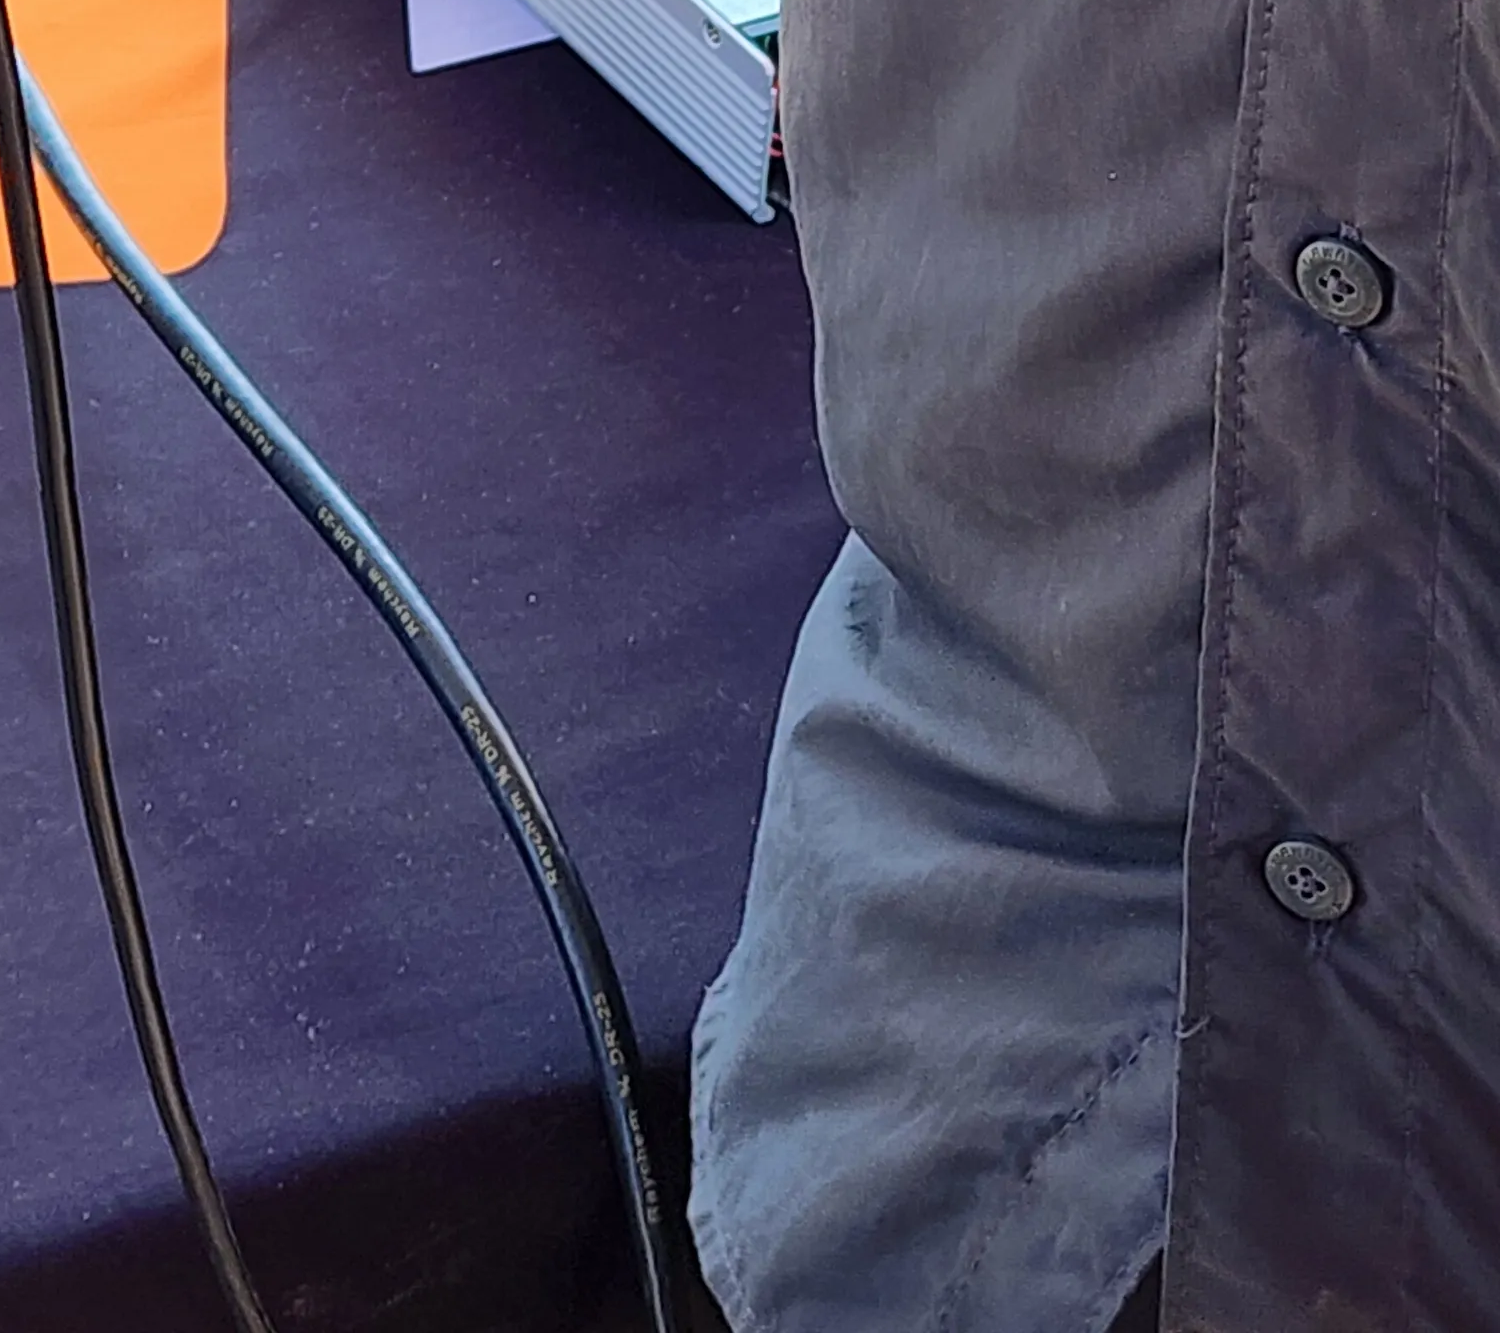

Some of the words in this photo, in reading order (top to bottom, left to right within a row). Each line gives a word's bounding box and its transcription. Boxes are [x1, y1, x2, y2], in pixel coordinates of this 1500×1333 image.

[223, 397, 275, 458] Raychem
[367, 566, 421, 639] Raychem
[509, 790, 558, 887] Raychem
[627, 1107, 664, 1224] Raychem
